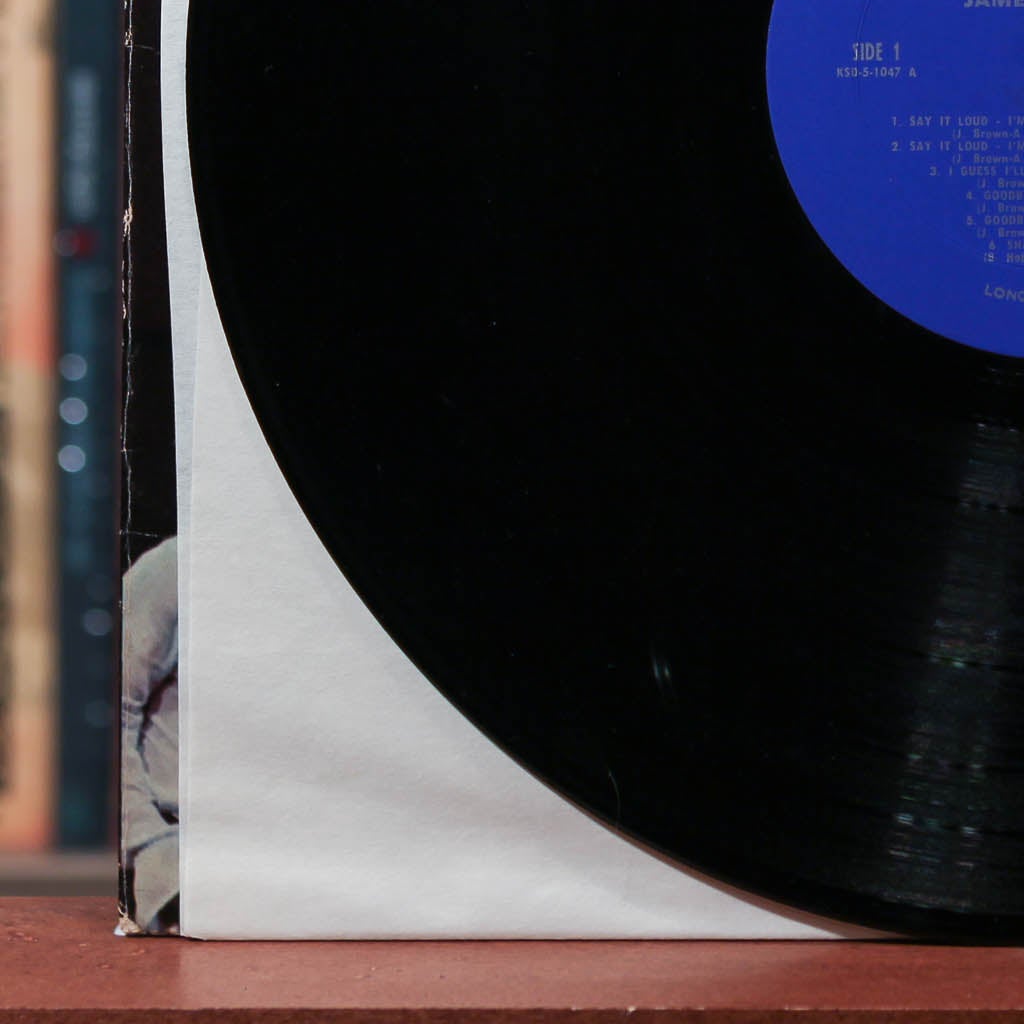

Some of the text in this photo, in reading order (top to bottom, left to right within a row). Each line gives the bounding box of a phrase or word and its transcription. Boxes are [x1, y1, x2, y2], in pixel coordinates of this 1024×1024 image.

[852, 41, 900, 61] SIDE 1
[908, 66, 917, 78] A
[909, 115, 932, 126] SAY
[940, 115, 951, 126] IT
[958, 115, 989, 126] LOUD
[909, 140, 932, 151] SAY
[940, 140, 951, 151] IT
[958, 140, 989, 151] LOUD
[960, 165, 997, 176] GUESS
